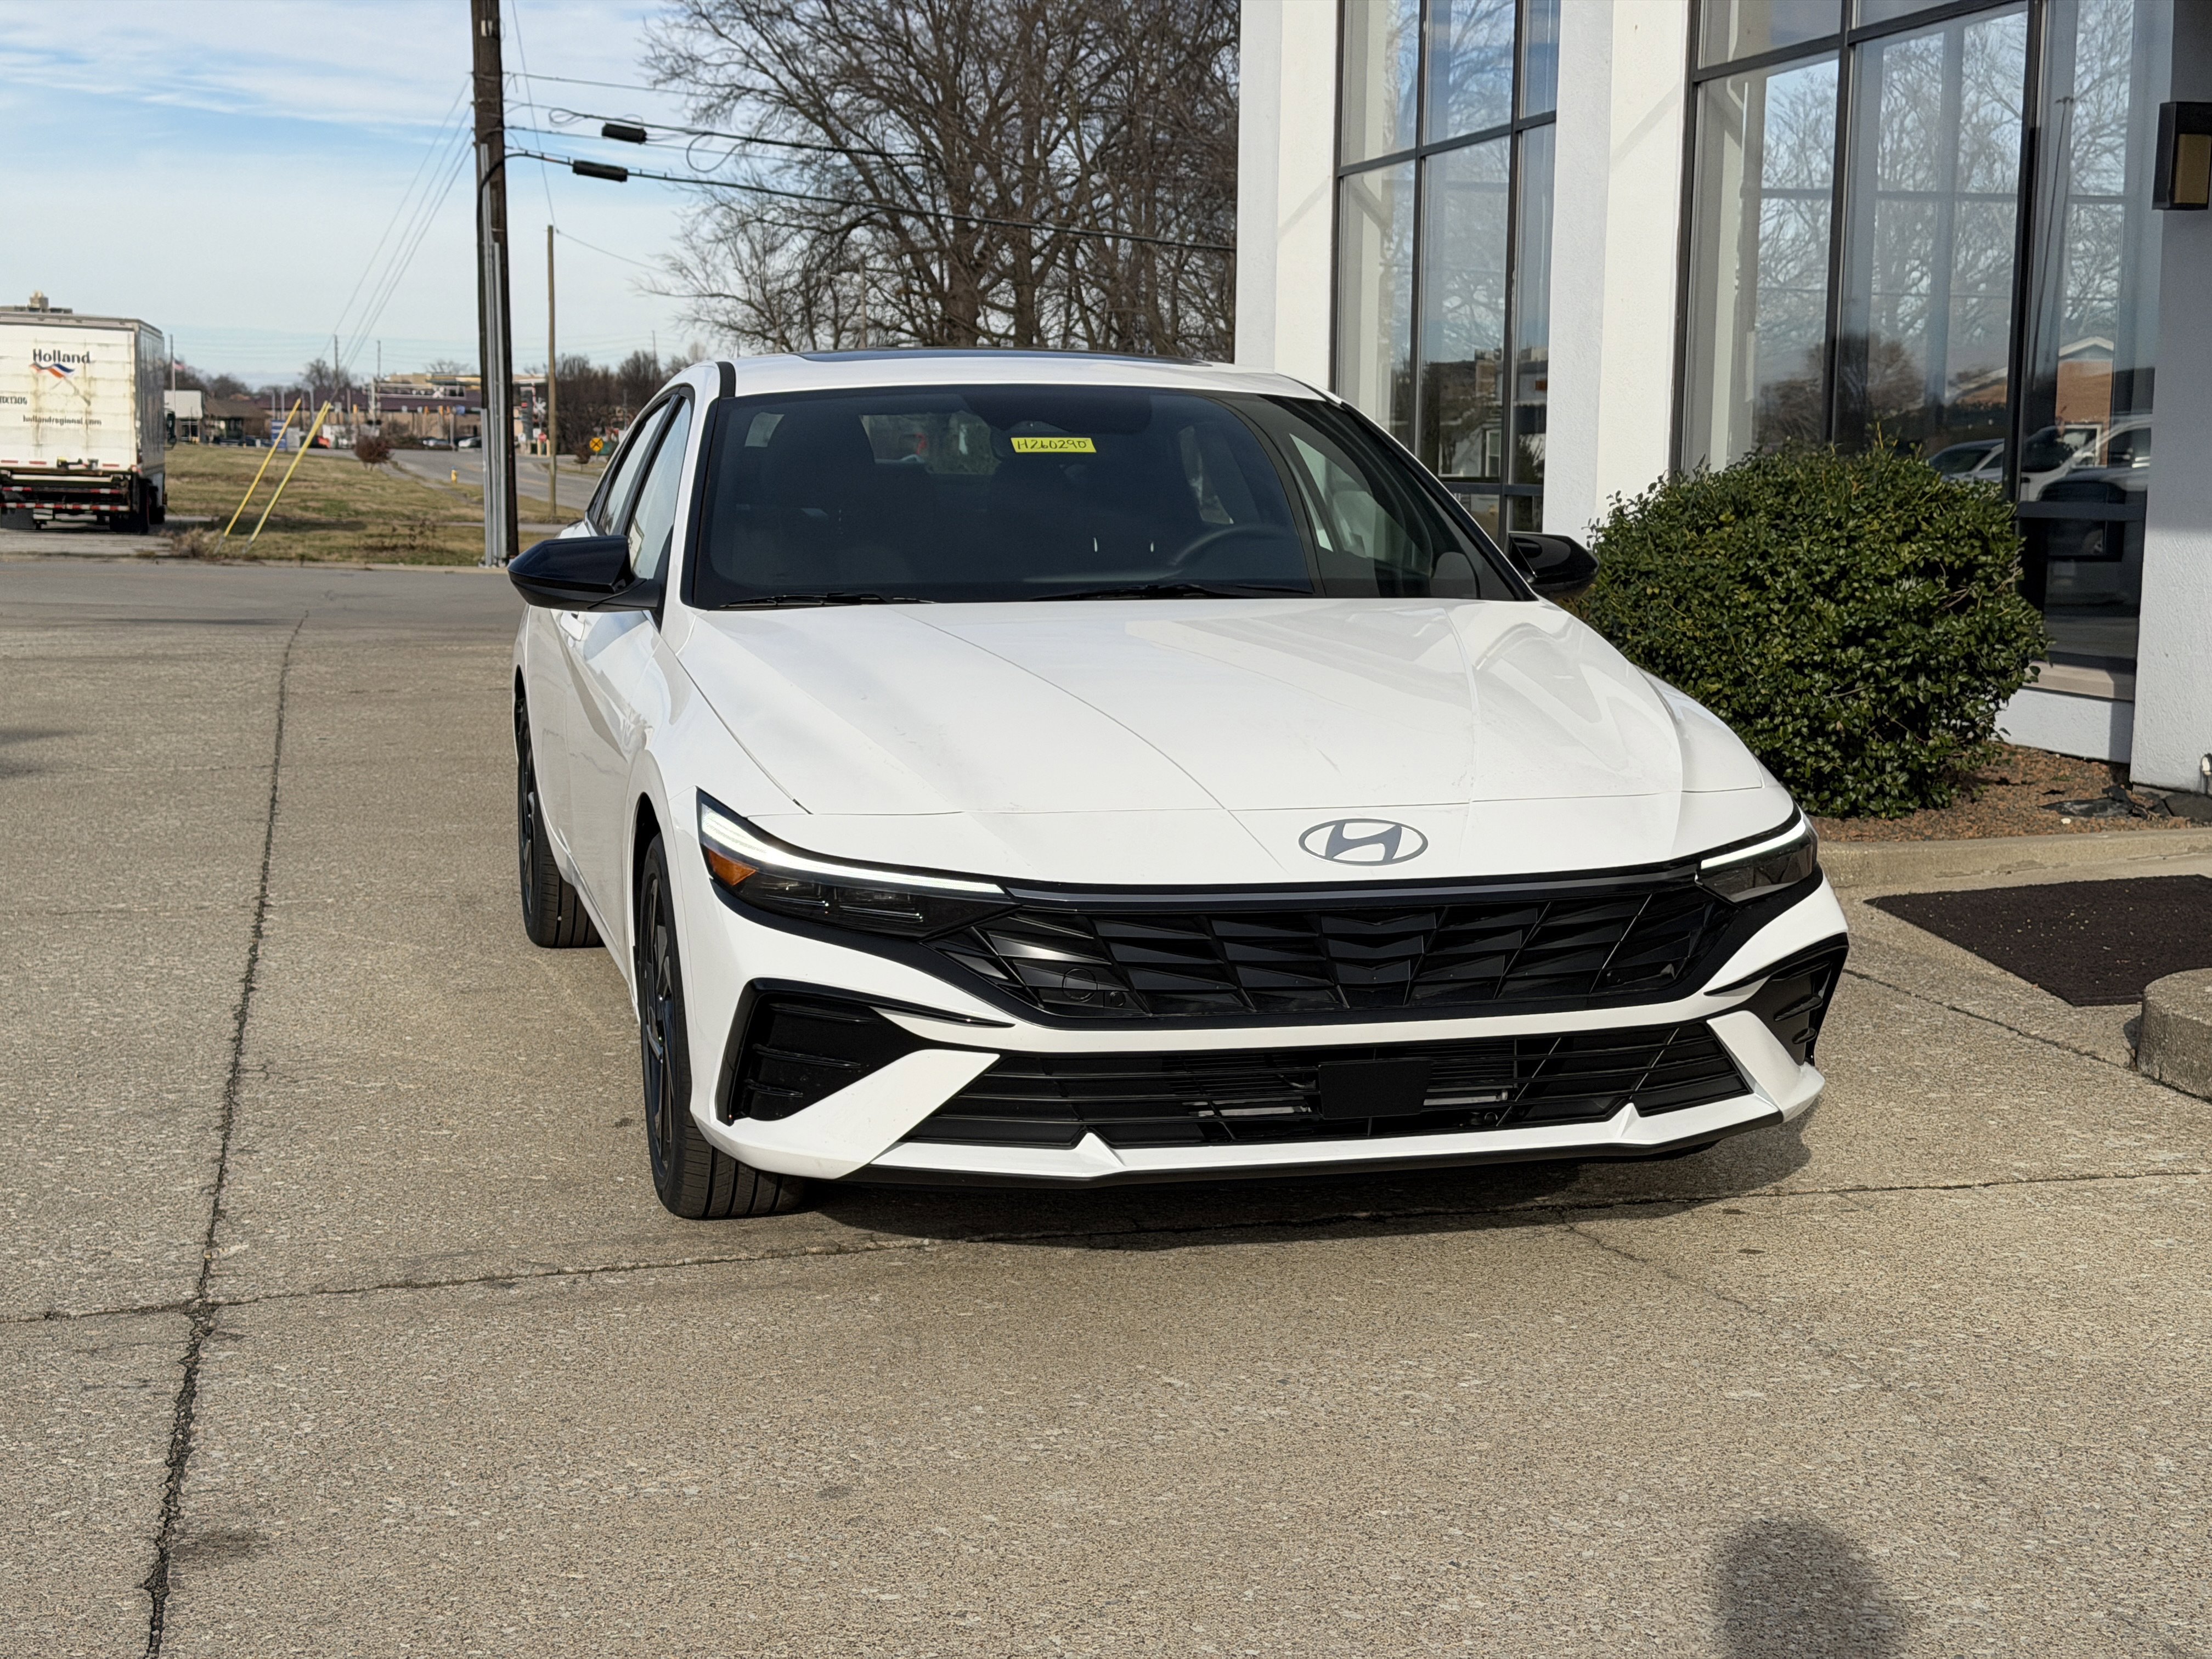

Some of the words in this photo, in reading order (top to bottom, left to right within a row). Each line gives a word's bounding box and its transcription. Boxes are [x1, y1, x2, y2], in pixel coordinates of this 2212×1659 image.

[33, 348, 90, 364] Holland
[23, 415, 101, 426] hollandregionalcom
[1018, 439, 1087, 449] H260290
